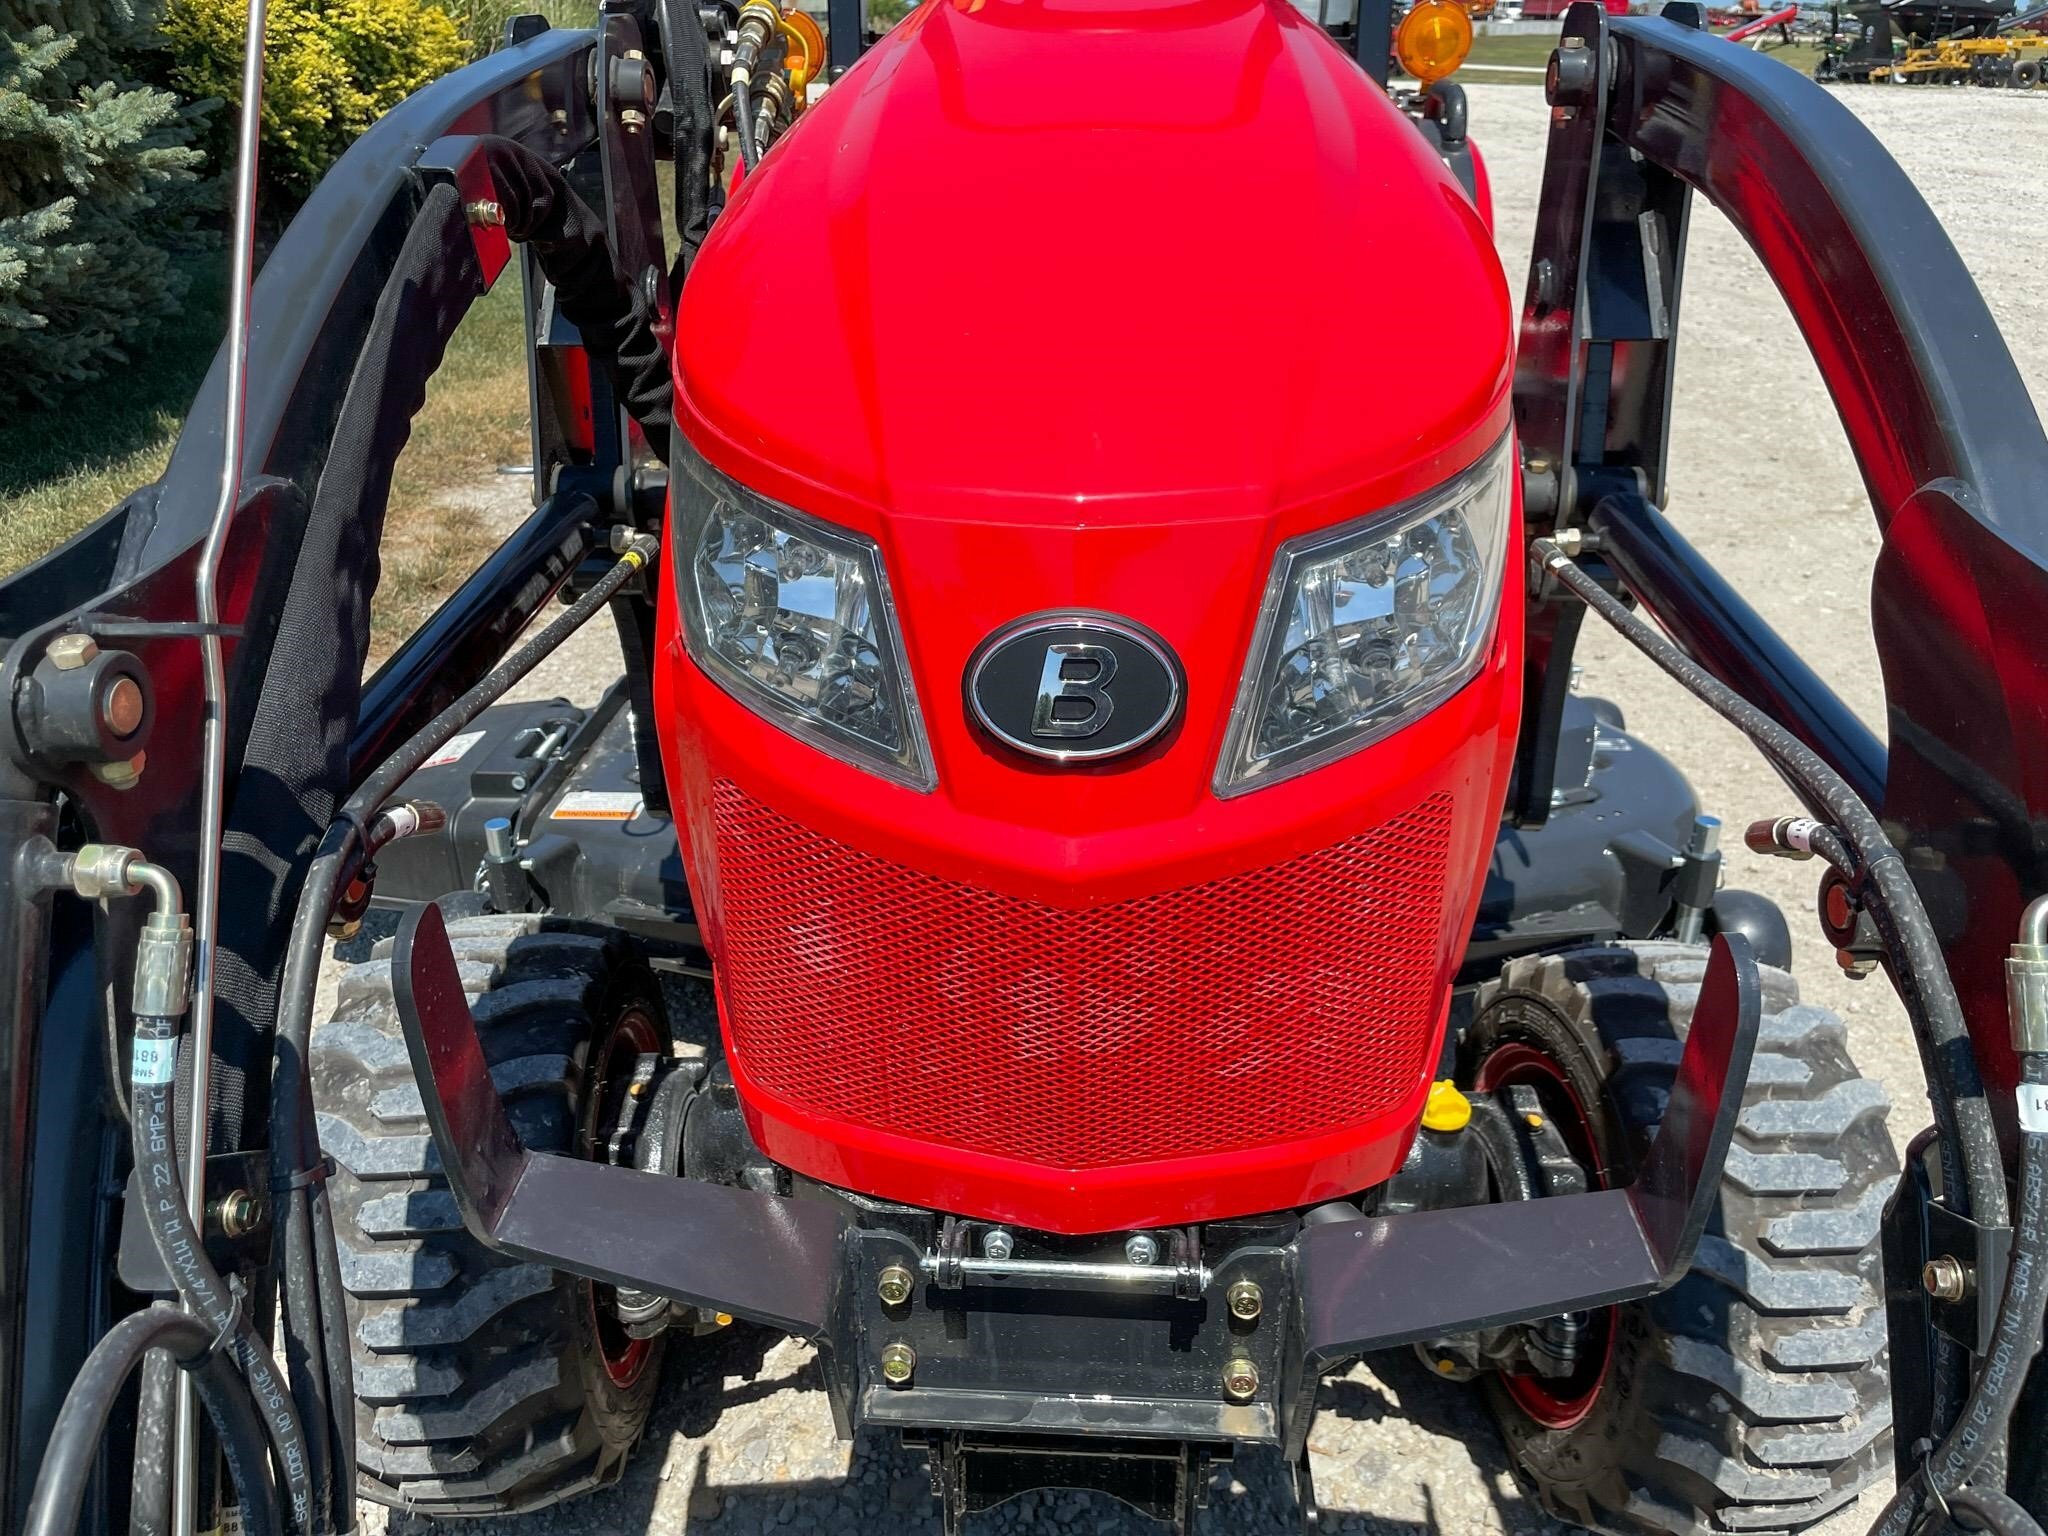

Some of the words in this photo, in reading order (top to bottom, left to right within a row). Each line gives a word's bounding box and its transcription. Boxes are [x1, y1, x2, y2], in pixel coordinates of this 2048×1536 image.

[1030, 645, 1118, 738] B
[2011, 1249, 2033, 1302] MADE
[2003, 1309, 2021, 1334] IN
[254, 1367, 284, 1409] SKIVE
[1985, 1339, 2014, 1397] KOREA
[276, 1412, 294, 1433] NO
[293, 1489, 308, 1523] SAE
